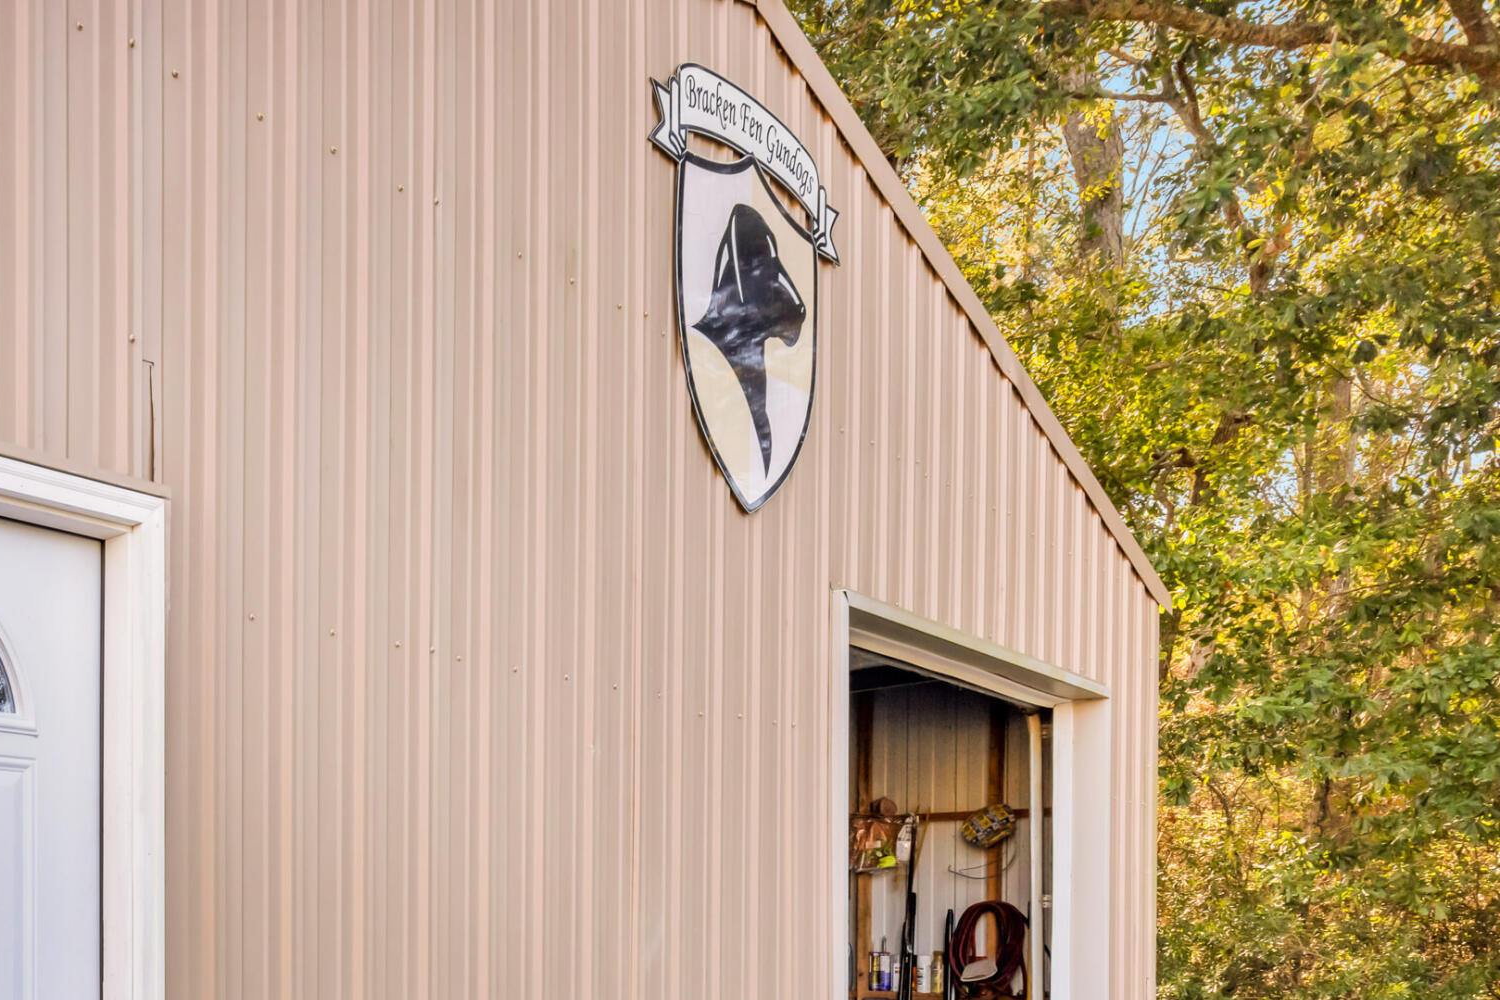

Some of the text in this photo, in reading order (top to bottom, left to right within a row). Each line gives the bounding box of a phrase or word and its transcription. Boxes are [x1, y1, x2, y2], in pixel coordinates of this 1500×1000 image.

[685, 74, 815, 197] Bracken Fen Gundogs
